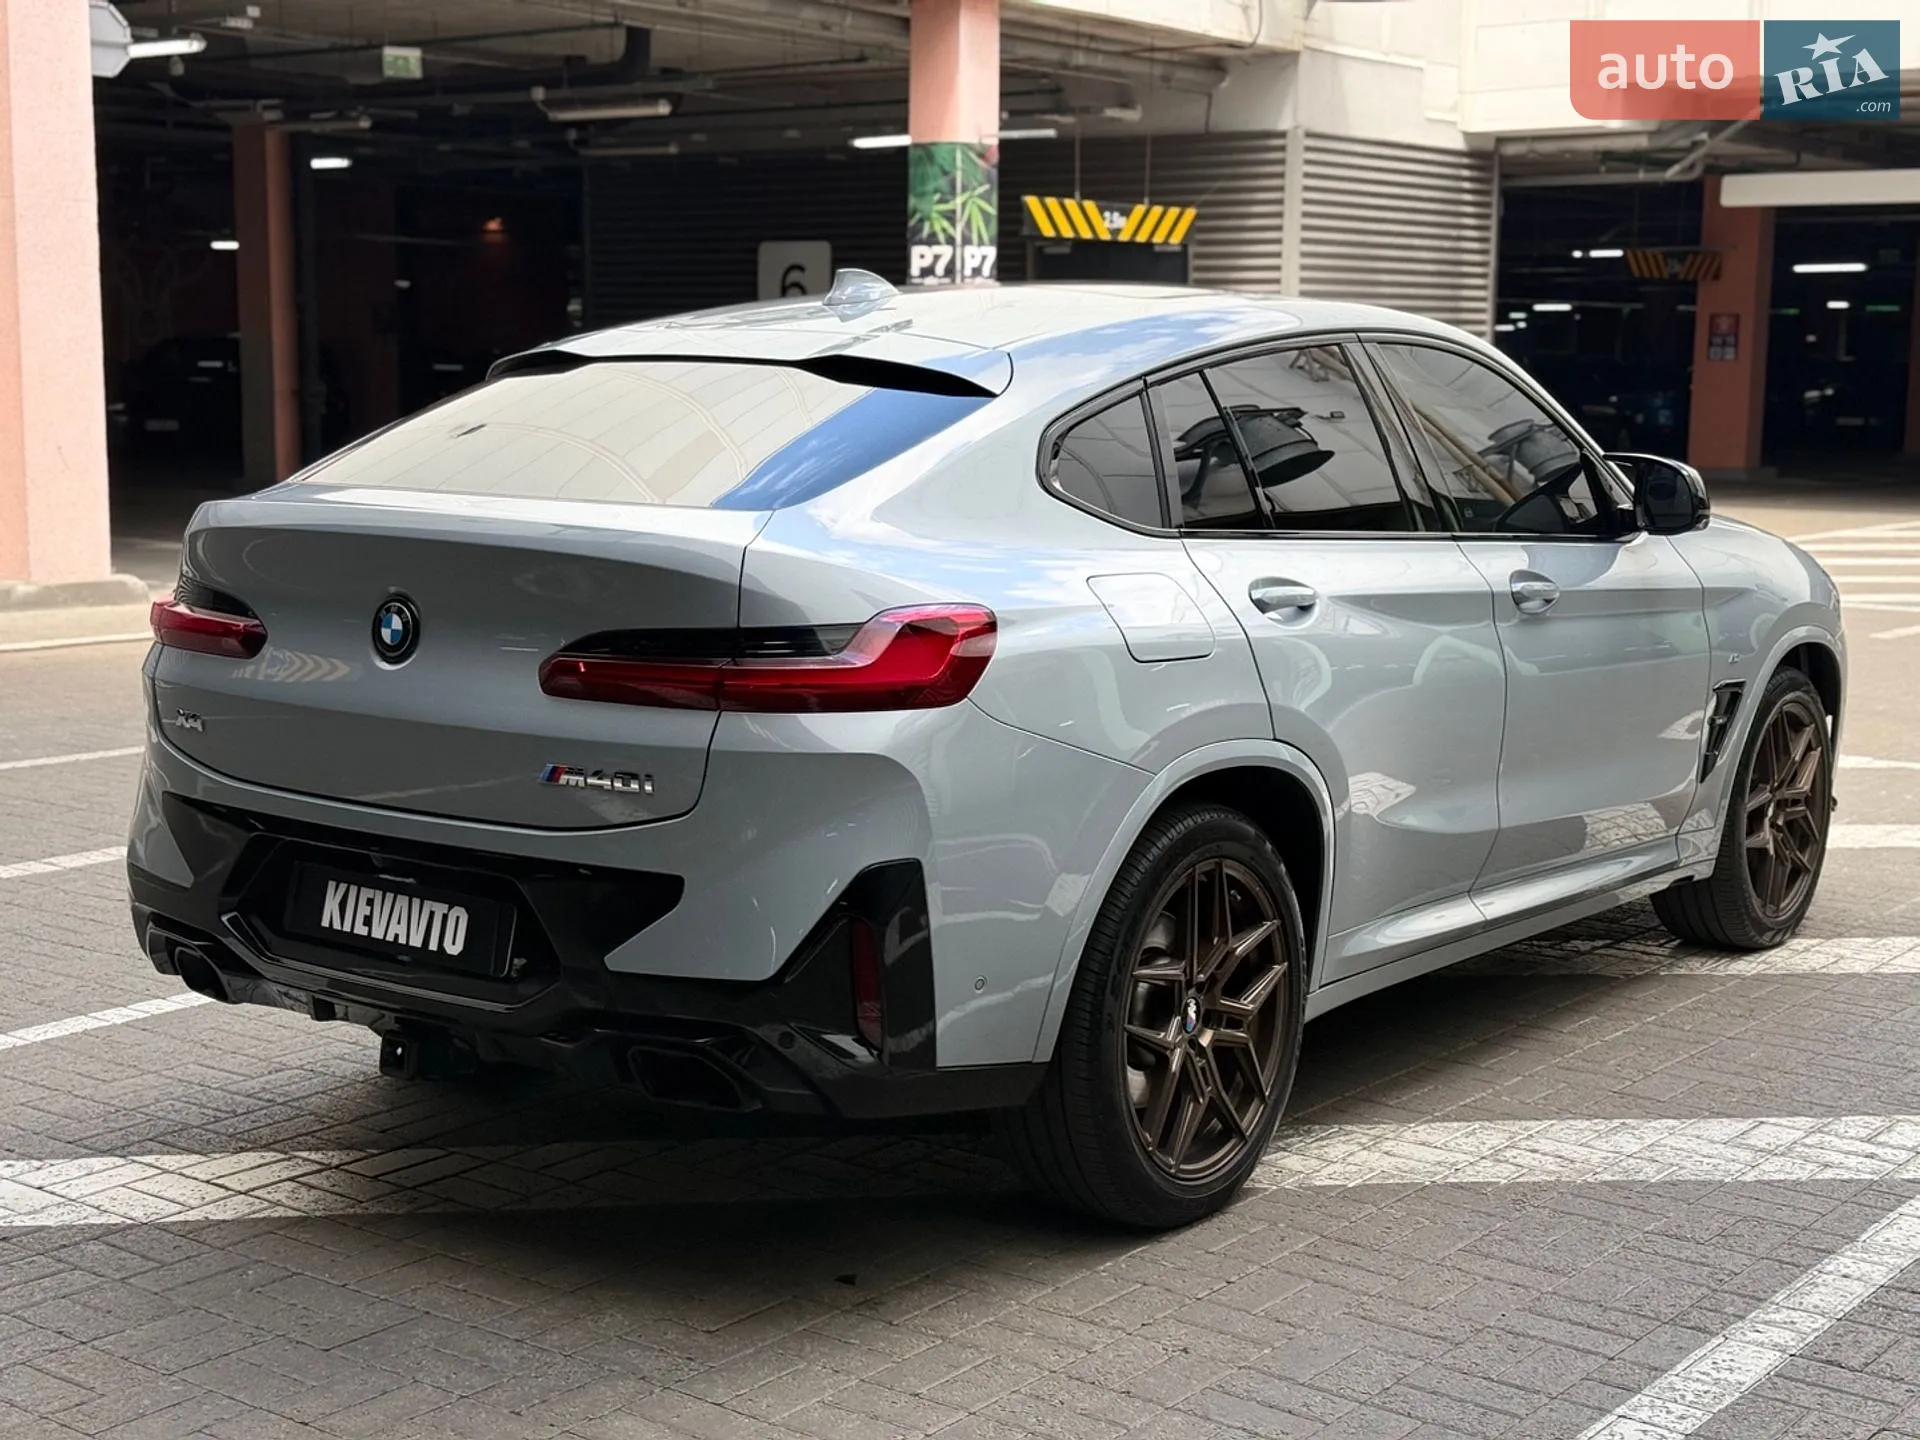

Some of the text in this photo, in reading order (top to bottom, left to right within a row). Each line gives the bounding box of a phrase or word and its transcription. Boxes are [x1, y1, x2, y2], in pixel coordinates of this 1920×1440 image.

[910, 244, 954, 277] P7
[963, 244, 997, 277] P7
[781, 264, 807, 296] 6
[540, 763, 654, 795] M40i
[321, 880, 469, 956] KIEVAVTO
